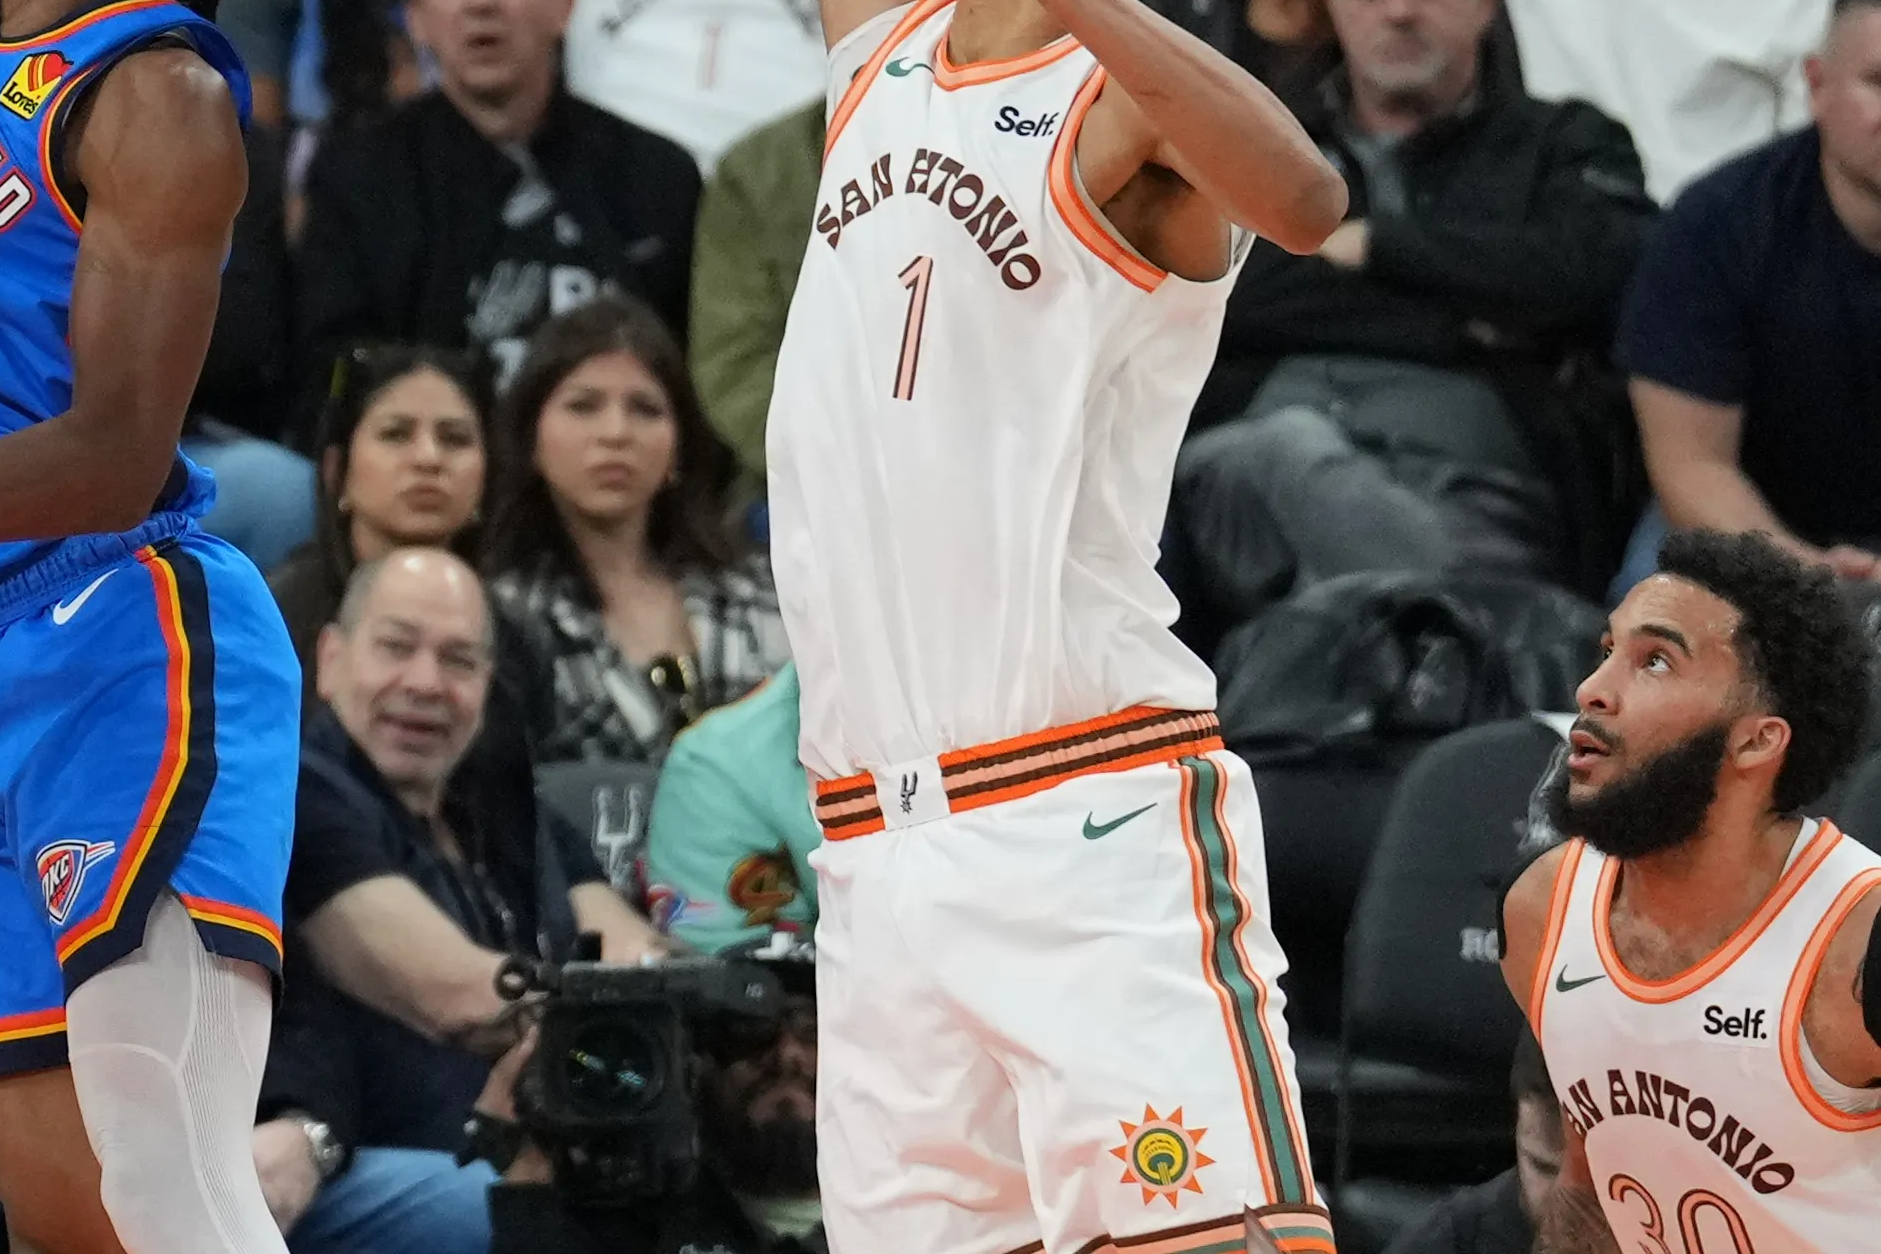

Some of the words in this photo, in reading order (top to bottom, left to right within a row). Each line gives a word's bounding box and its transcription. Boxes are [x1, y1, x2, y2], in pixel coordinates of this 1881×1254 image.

[994, 106, 1059, 137] Self.
[817, 153, 894, 251] SAN
[892, 256, 933, 401] 1
[1703, 1005, 1768, 1040] Self.
[1562, 1077, 1605, 1140] AN
[1606, 1068, 1795, 1194] ANTONIO
